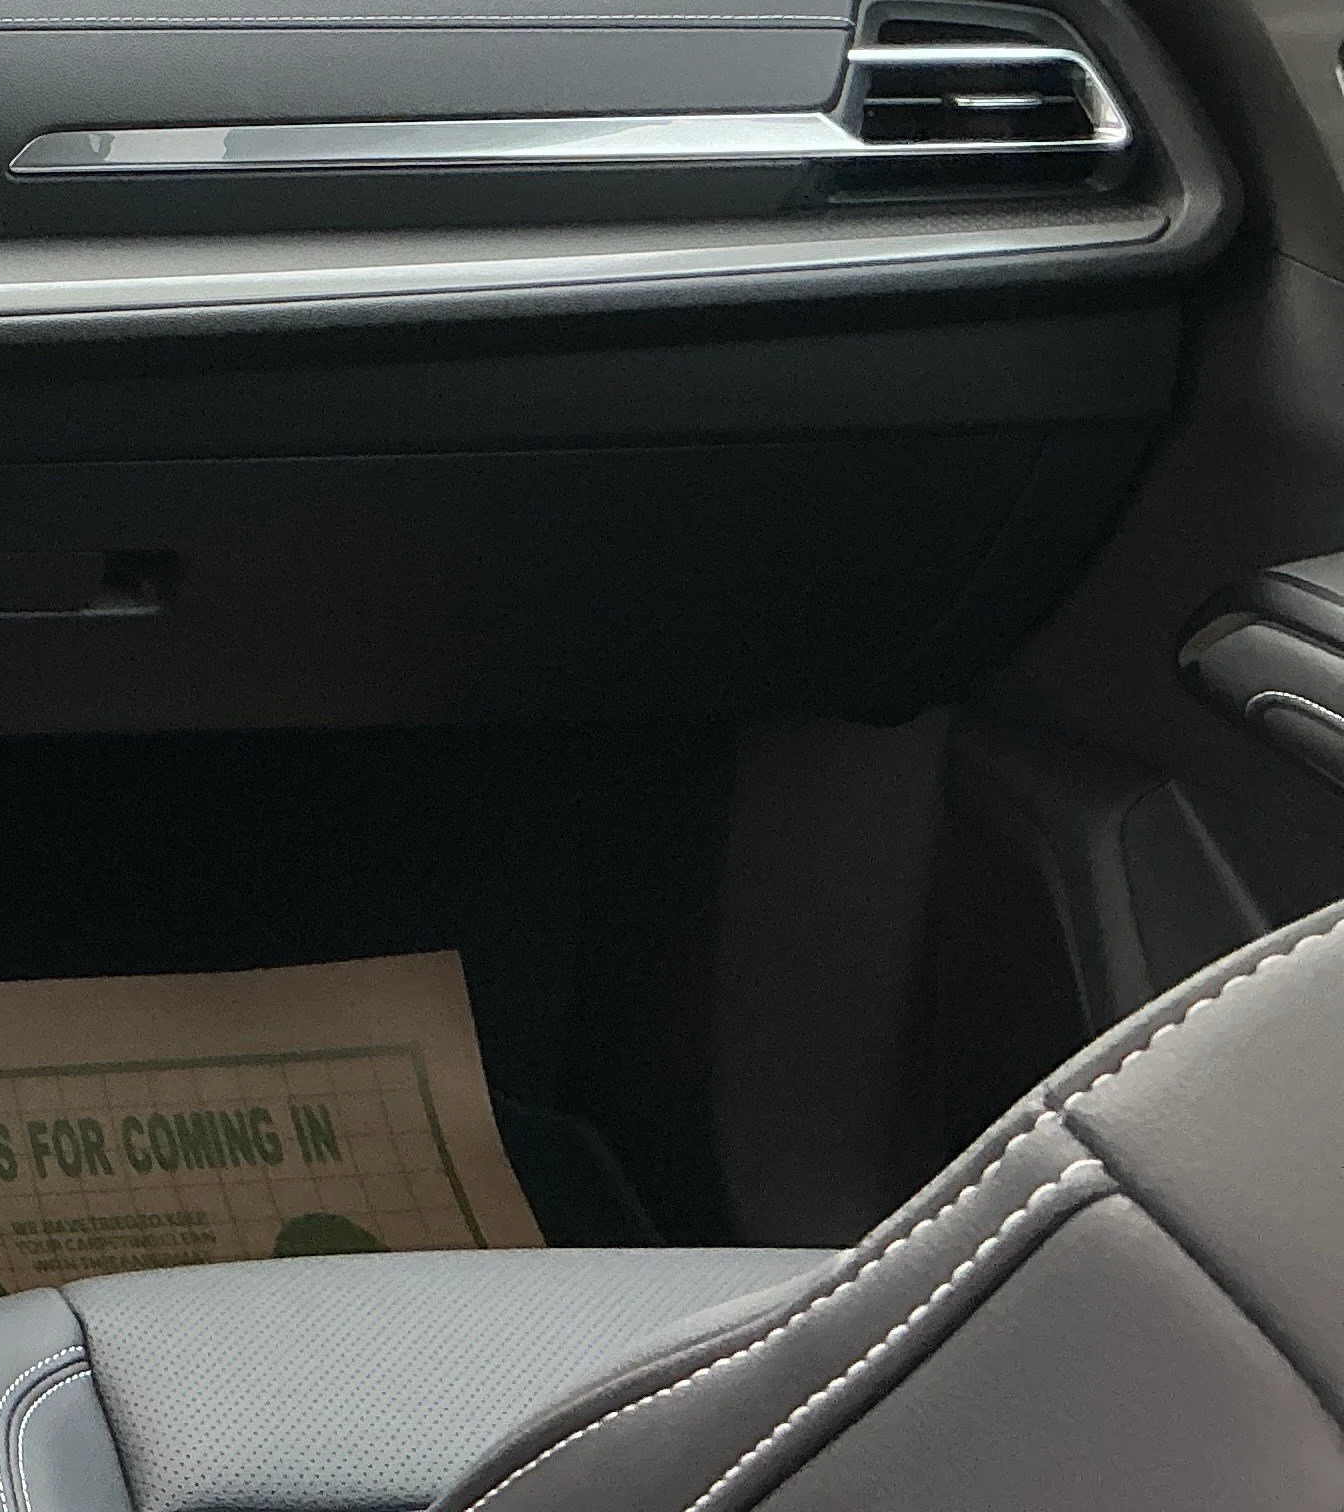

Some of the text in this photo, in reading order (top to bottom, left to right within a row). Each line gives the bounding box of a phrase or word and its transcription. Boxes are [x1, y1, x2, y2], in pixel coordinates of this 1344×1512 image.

[27, 1116, 113, 1181] FOR
[120, 1106, 284, 1175] COMING
[292, 1102, 342, 1166] IN
